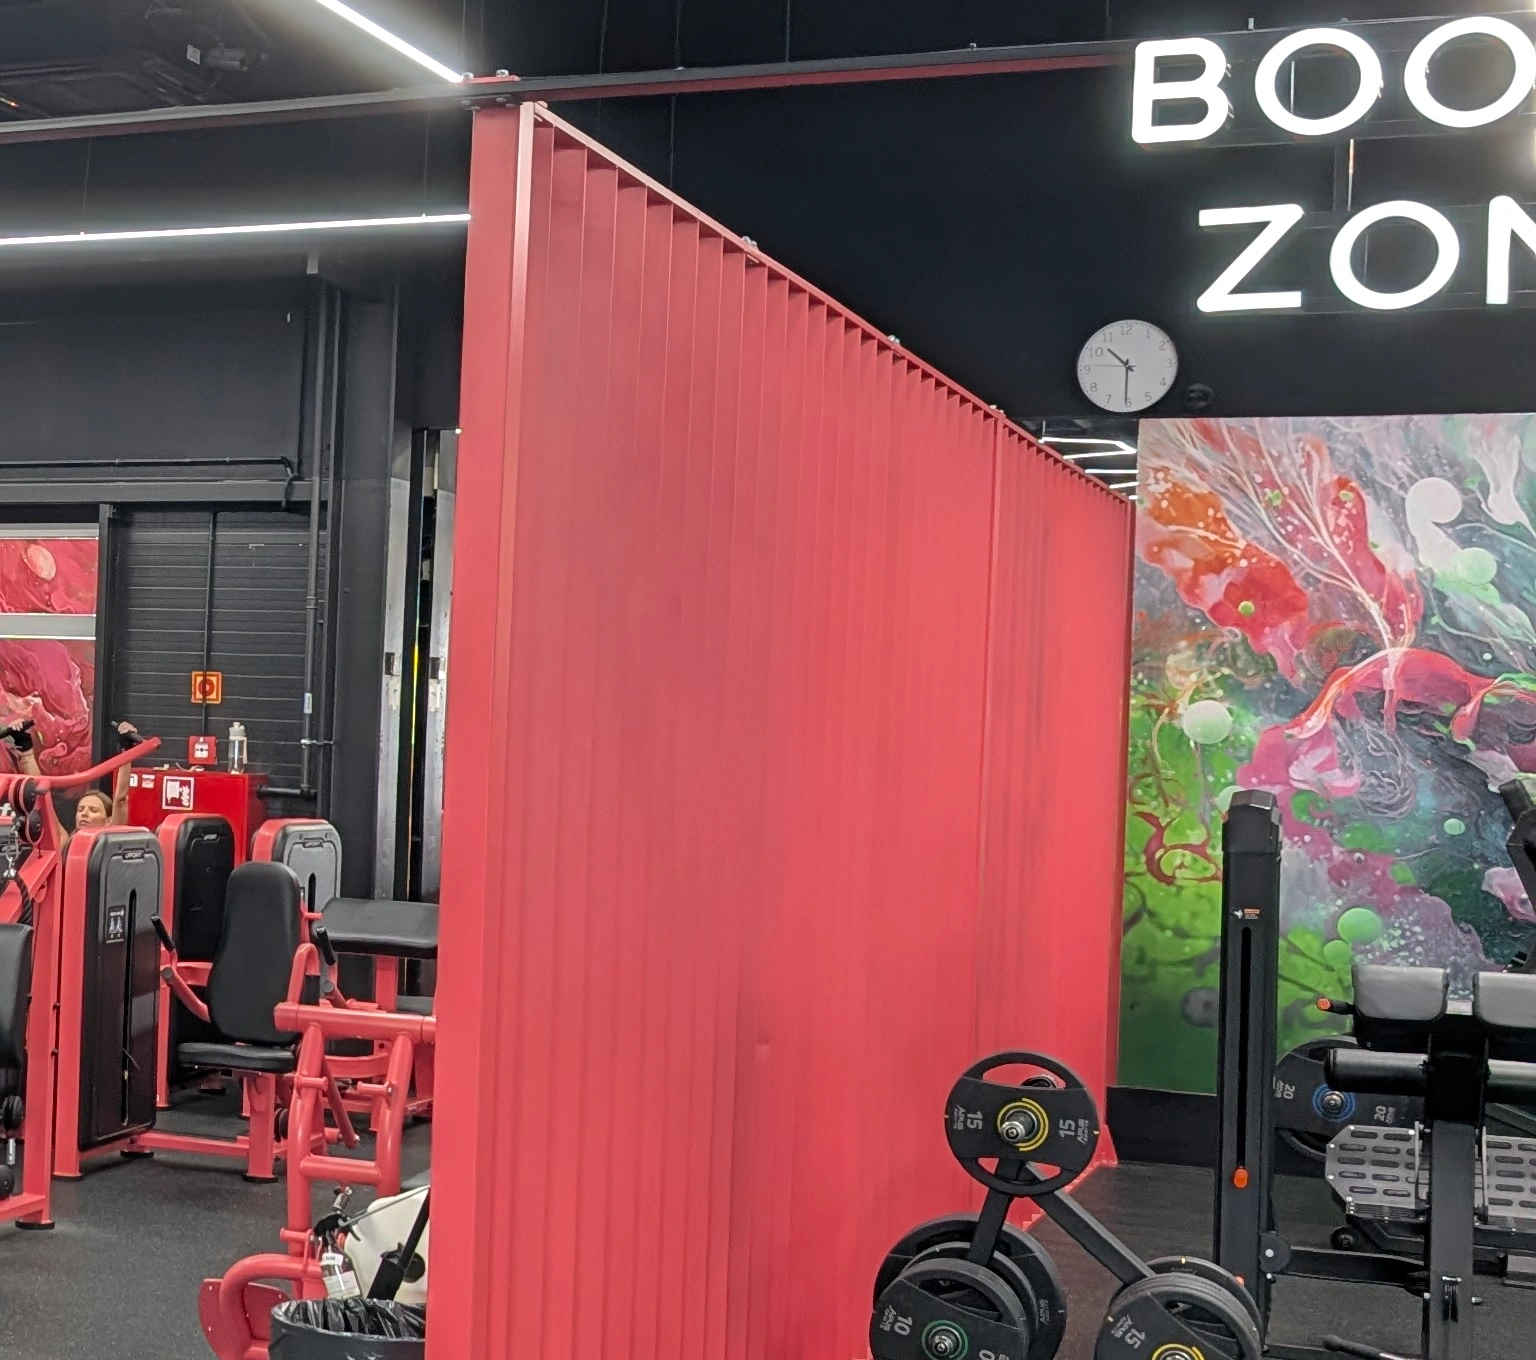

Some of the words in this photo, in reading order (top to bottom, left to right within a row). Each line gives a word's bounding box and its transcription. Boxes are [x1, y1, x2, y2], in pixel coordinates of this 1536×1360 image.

[1120, 323, 1133, 336] 12
[1102, 332, 1114, 343] 11
[1158, 340, 1166, 351] 2
[1089, 346, 1104, 358] 10
[1166, 358, 1173, 369] 3
[1083, 364, 1091, 375] 9
[1159, 377, 1166, 386] 4
[1089, 382, 1098, 393] 8
[1105, 394, 1112, 405] 7
[1144, 391, 1152, 402] 5
[1284, 1083, 1295, 1100] 20
[1373, 1105, 1386, 1122] 20
[966, 1111, 983, 1130] 15
[1058, 1118, 1076, 1138] 15
[893, 1315, 913, 1336] 10
[1124, 1328, 1146, 1349] 15
